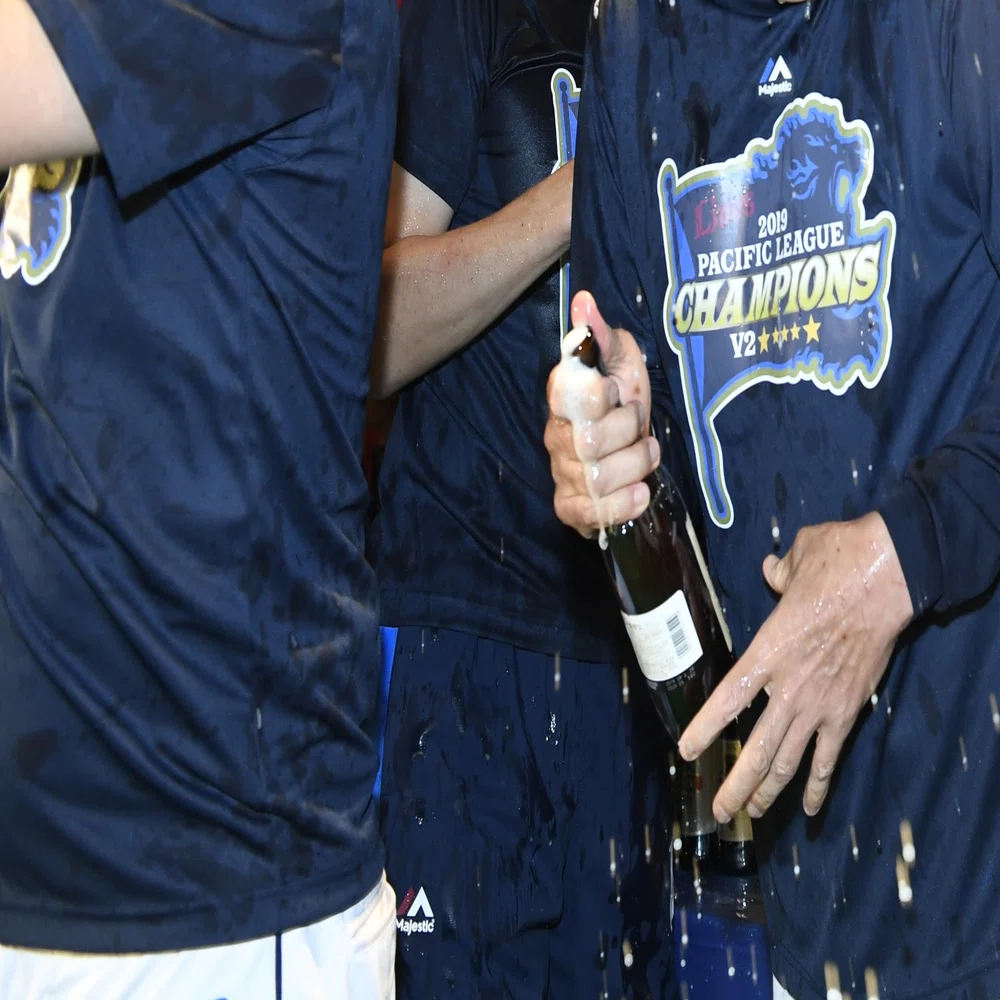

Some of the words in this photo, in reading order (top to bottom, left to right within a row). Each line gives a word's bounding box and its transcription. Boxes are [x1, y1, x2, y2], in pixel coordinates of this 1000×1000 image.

[758, 81, 792, 97] Majestic
[758, 208, 788, 239] 2019
[698, 240, 772, 277] PACIFIC
[775, 221, 845, 261] LEAGUE
[674, 240, 882, 334] CHAMPIONS
[729, 330, 756, 358] V2
[396, 918, 435, 936] Majestic
